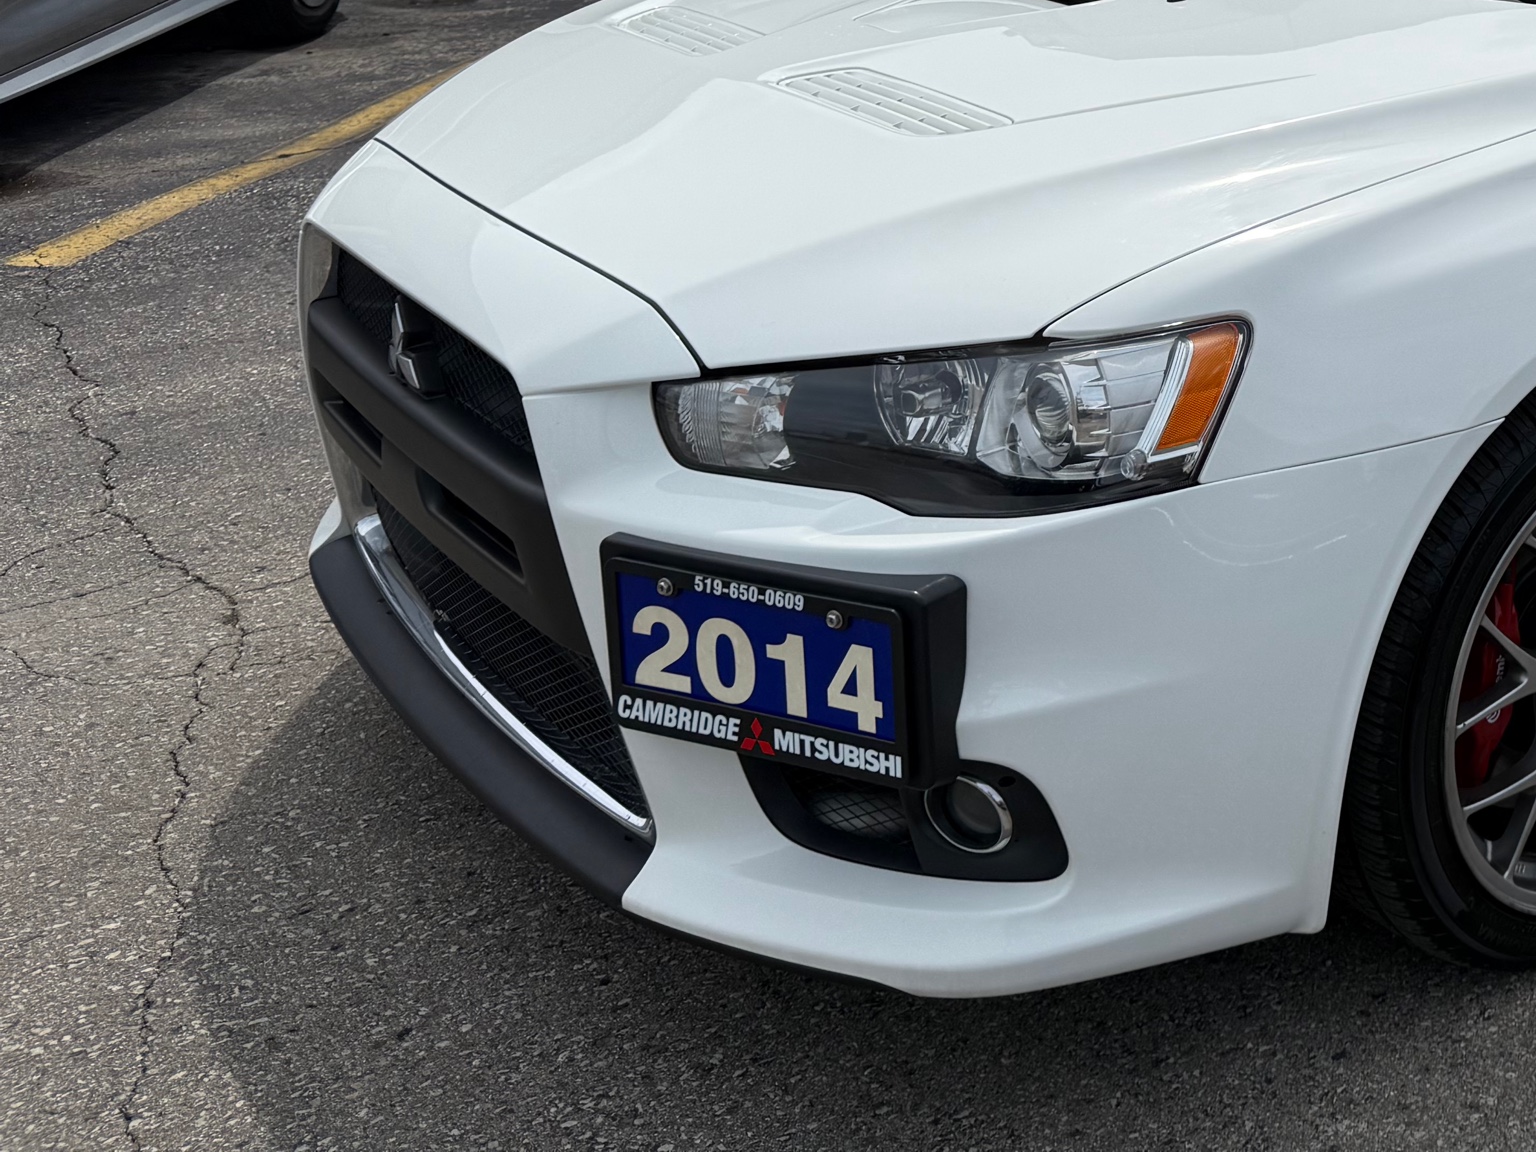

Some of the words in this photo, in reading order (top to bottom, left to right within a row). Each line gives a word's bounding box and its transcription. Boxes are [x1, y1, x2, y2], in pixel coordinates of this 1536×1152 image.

[694, 575, 804, 611] 519-650-0609
[632, 605, 883, 734] 2014
[617, 694, 741, 741] CAMBRIDGE
[773, 728, 903, 779] MITSUBISHI
